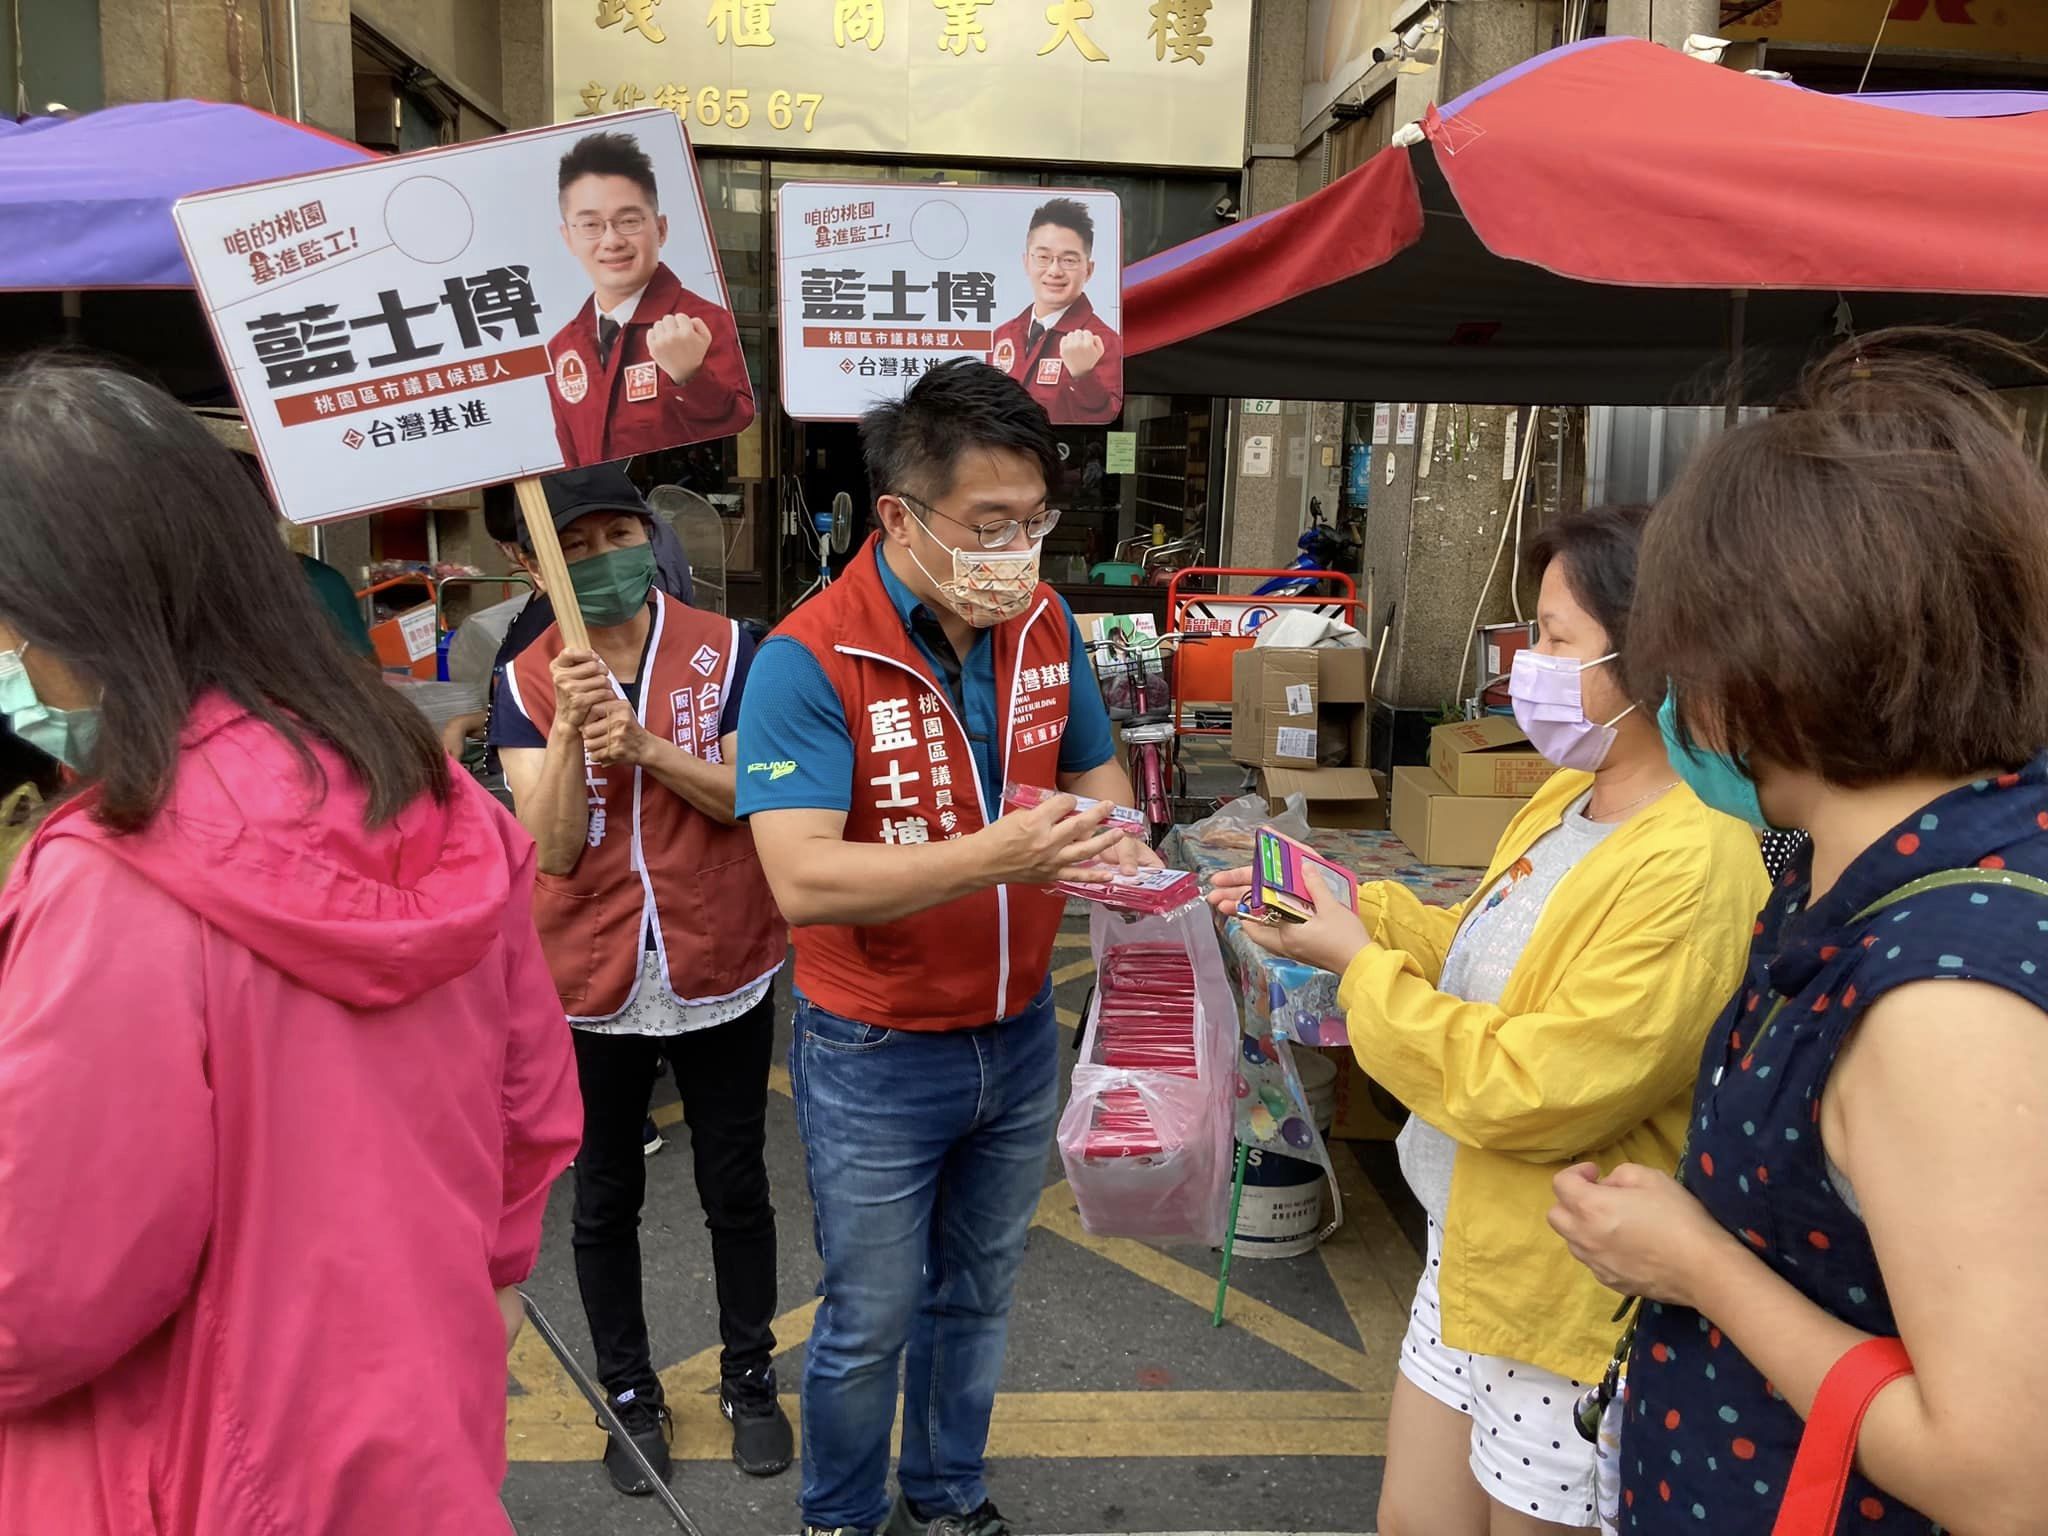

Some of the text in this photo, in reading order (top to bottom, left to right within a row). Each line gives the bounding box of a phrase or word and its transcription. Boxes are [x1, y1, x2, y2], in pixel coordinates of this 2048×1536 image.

[767, 89, 824, 132] 67
[224, 200, 327, 254] 咱的桃園
[804, 201, 874, 226] 咱的桃園
[801, 268, 997, 323] 藍士博
[246, 264, 544, 389] 藍士博
[828, 330, 965, 347] 桃園區市議員候選人
[314, 362, 511, 414] 桃園區市議員候選人
[1255, 400, 1273, 412] 67
[367, 400, 492, 448] 台灣基進
[918, 693, 962, 840] 桃園區議員參
